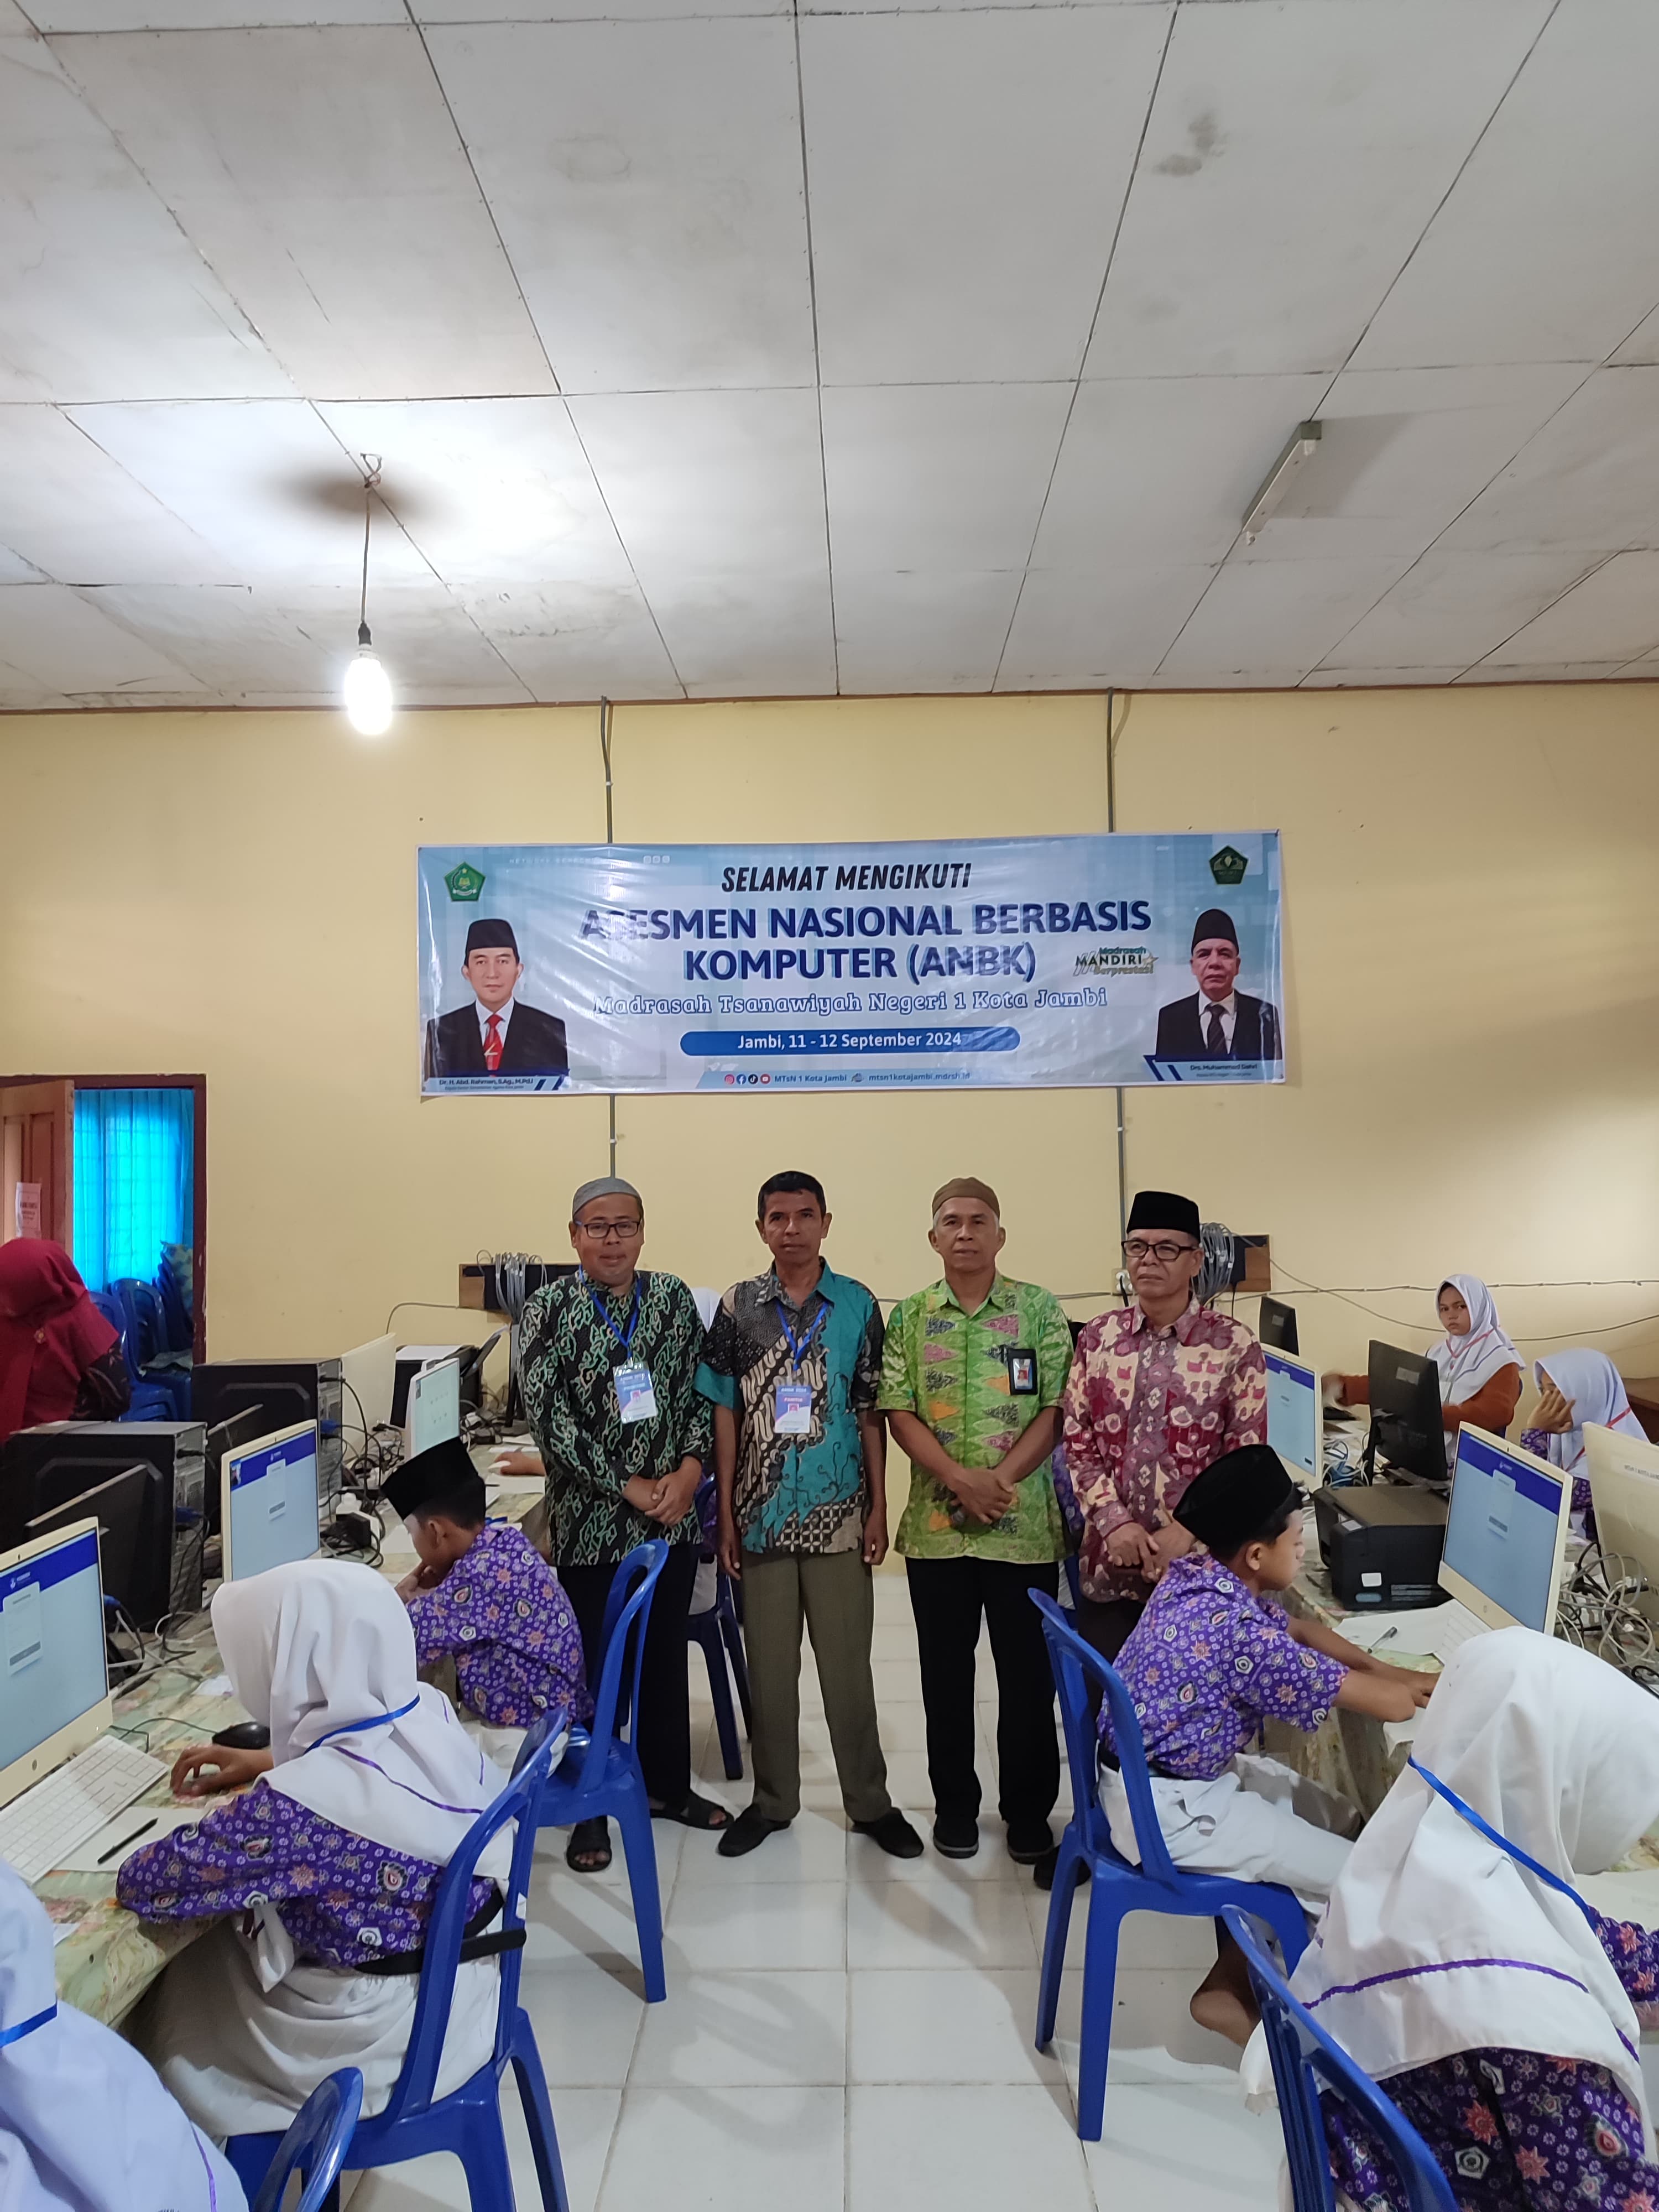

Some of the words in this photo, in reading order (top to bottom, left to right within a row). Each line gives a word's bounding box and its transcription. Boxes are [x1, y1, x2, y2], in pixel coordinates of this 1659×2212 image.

[722, 866, 829, 891] SELAMAT
[834, 863, 972, 890] MENGIKUTI
[769, 905, 962, 938] NASIONAL
[972, 900, 1152, 935] BERBASIS
[684, 947, 898, 980] KOMPUTER
[907, 942, 1036, 985] (ANBK)
[1076, 954, 1142, 966] MANDIRI
[593, 995, 712, 1014] Madrasah
[718, 993, 862, 1016] Tsanawiyah
[869, 992, 947, 1015] Negeri
[954, 992, 966, 1010] 1
[973, 991, 1028, 1009] Kota
[1035, 987, 1108, 1008] Jambi
[738, 1035, 785, 1050] Jambi,
[789, 1035, 805, 1048] 11
[821, 1035, 837, 1048] 12
[842, 1032, 922, 1050] September
[926, 1032, 962, 1046] 2024
[824, 1074, 847, 1083] Jambi
